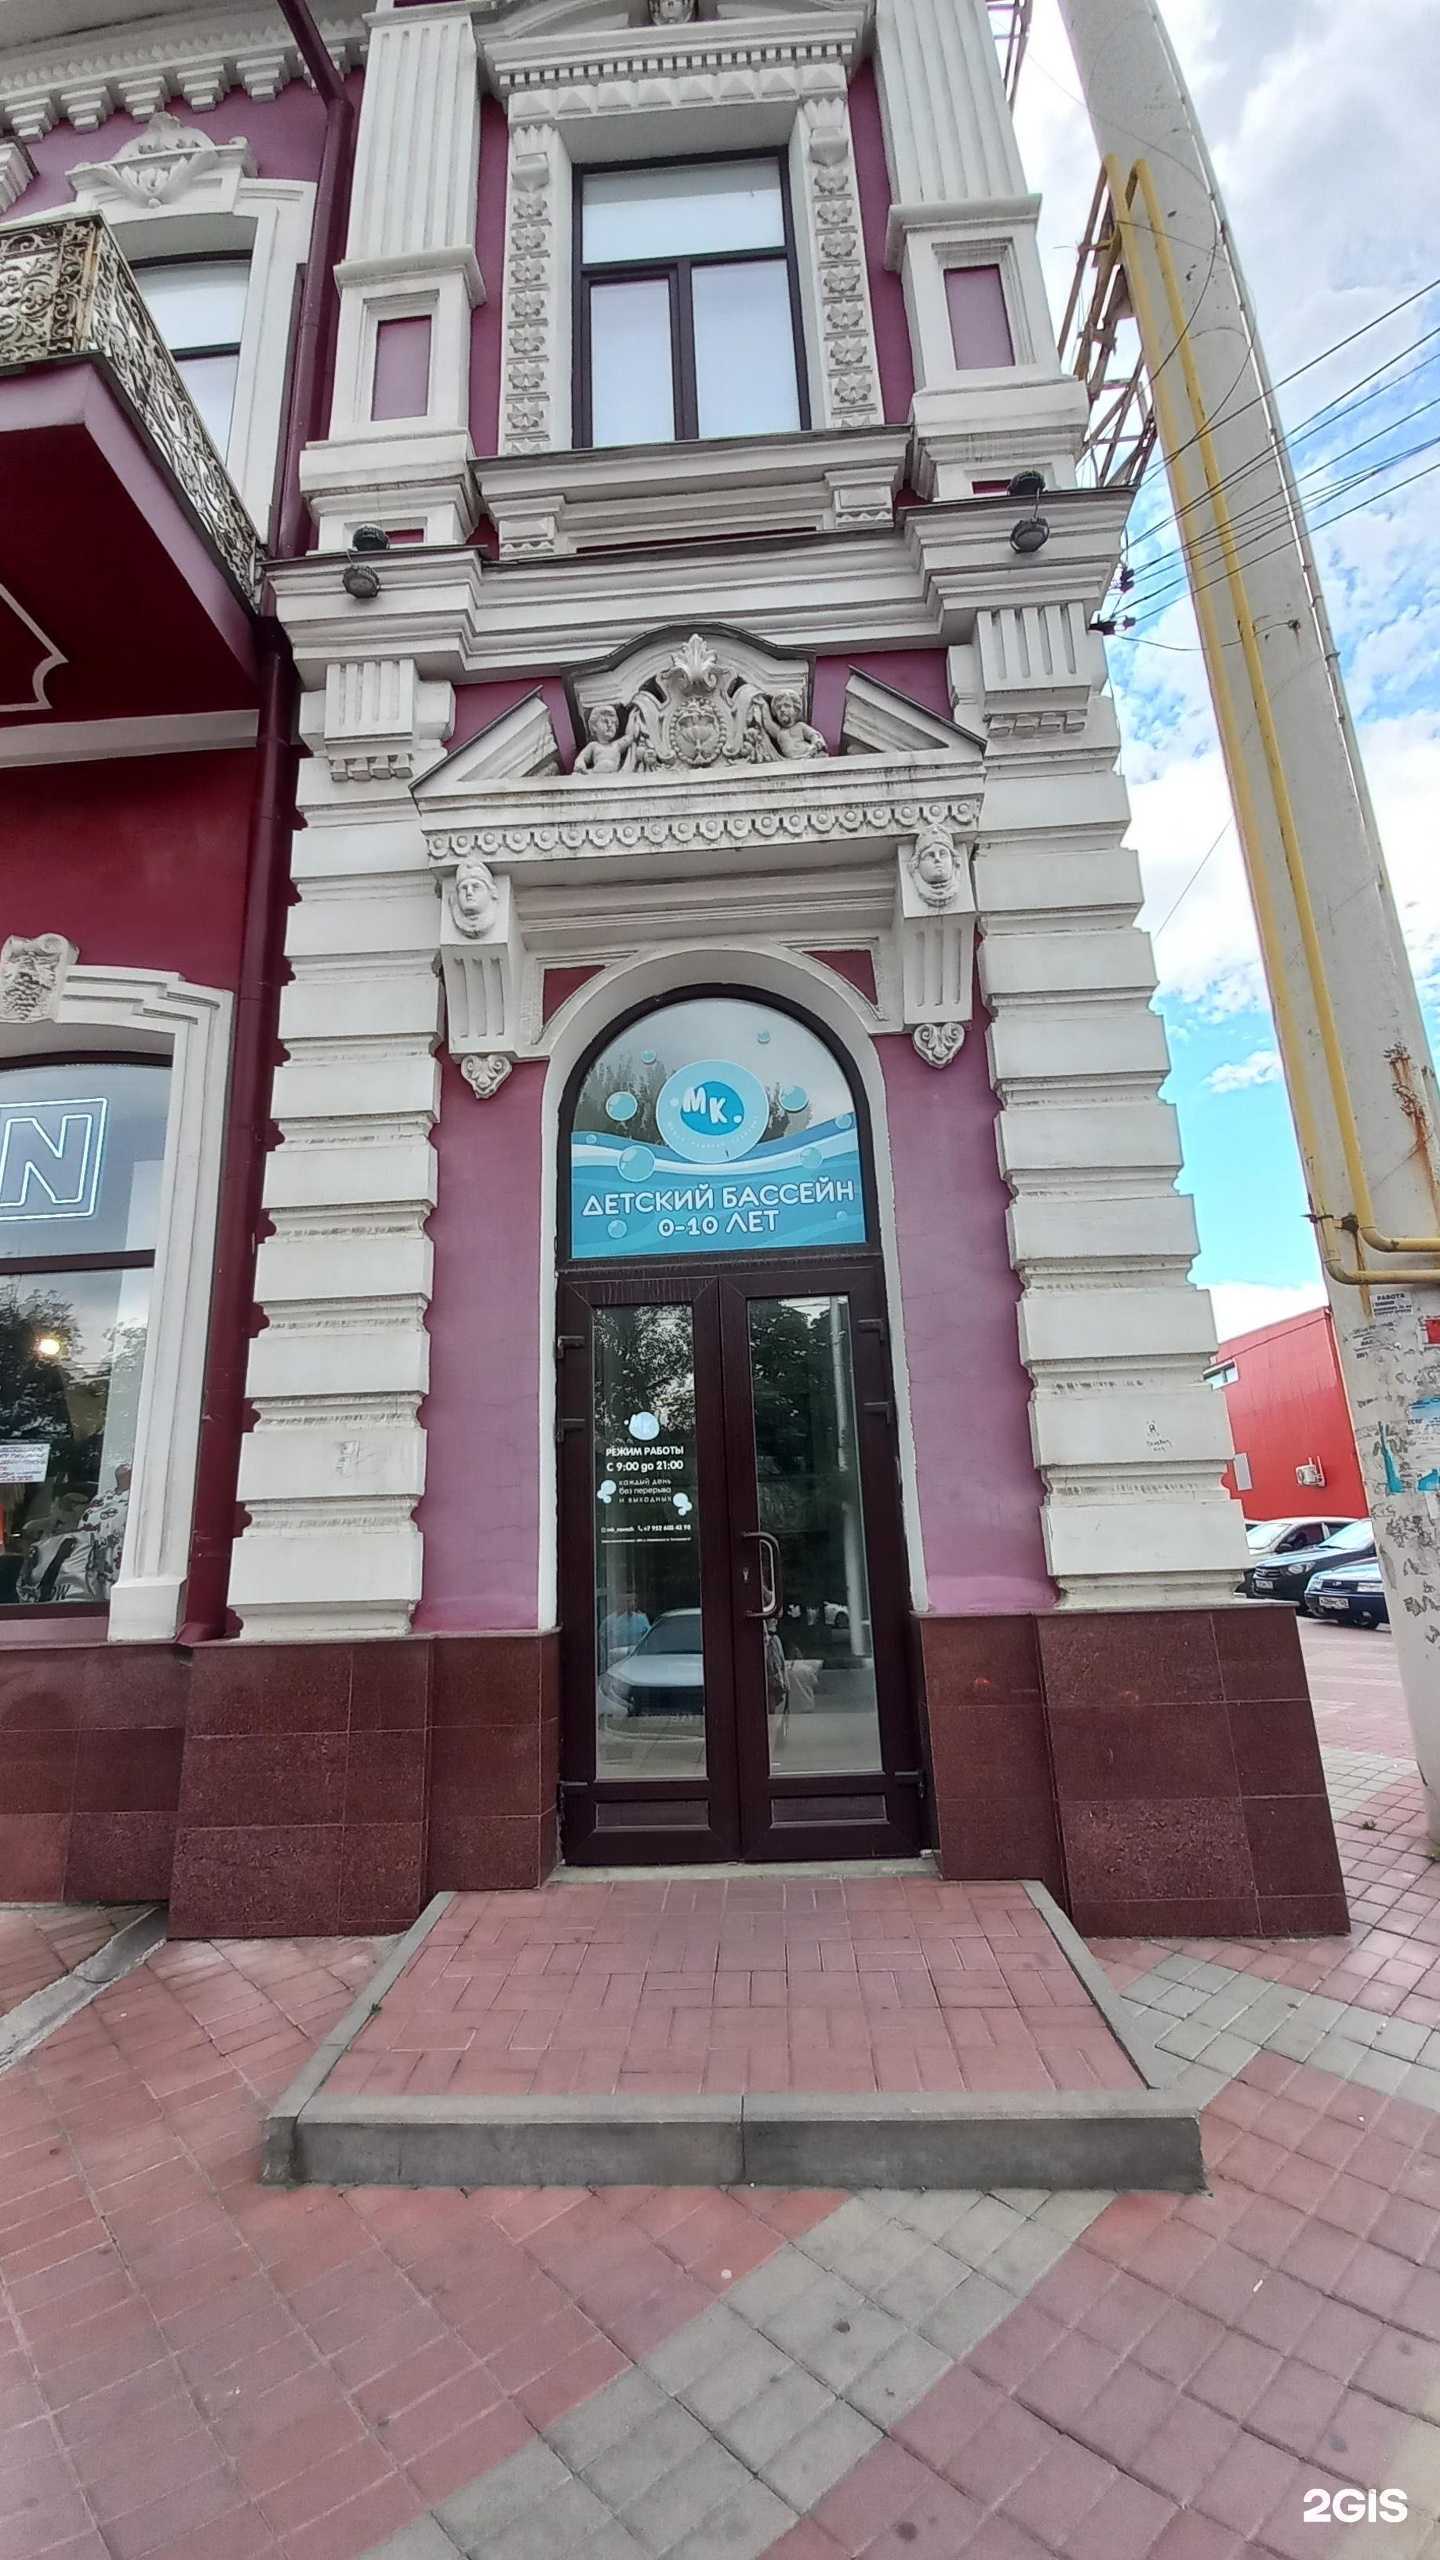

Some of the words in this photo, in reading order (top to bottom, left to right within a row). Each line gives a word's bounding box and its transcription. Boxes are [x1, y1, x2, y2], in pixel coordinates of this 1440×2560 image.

[582, 1184, 715, 1217] ДЕТСКИЙ
[722, 1176, 855, 1208] БАССЕЙН
[658, 1216, 719, 1237] 0-10
[725, 1210, 780, 1233] ЛЕТ
[605, 1447, 642, 1457] РЕЖИМ
[644, 1446, 684, 1456] РАБОТЫ
[616, 1461, 639, 1472] 9:00
[656, 1460, 684, 1471] 21:00
[634, 1486, 672, 1495] перерыва
